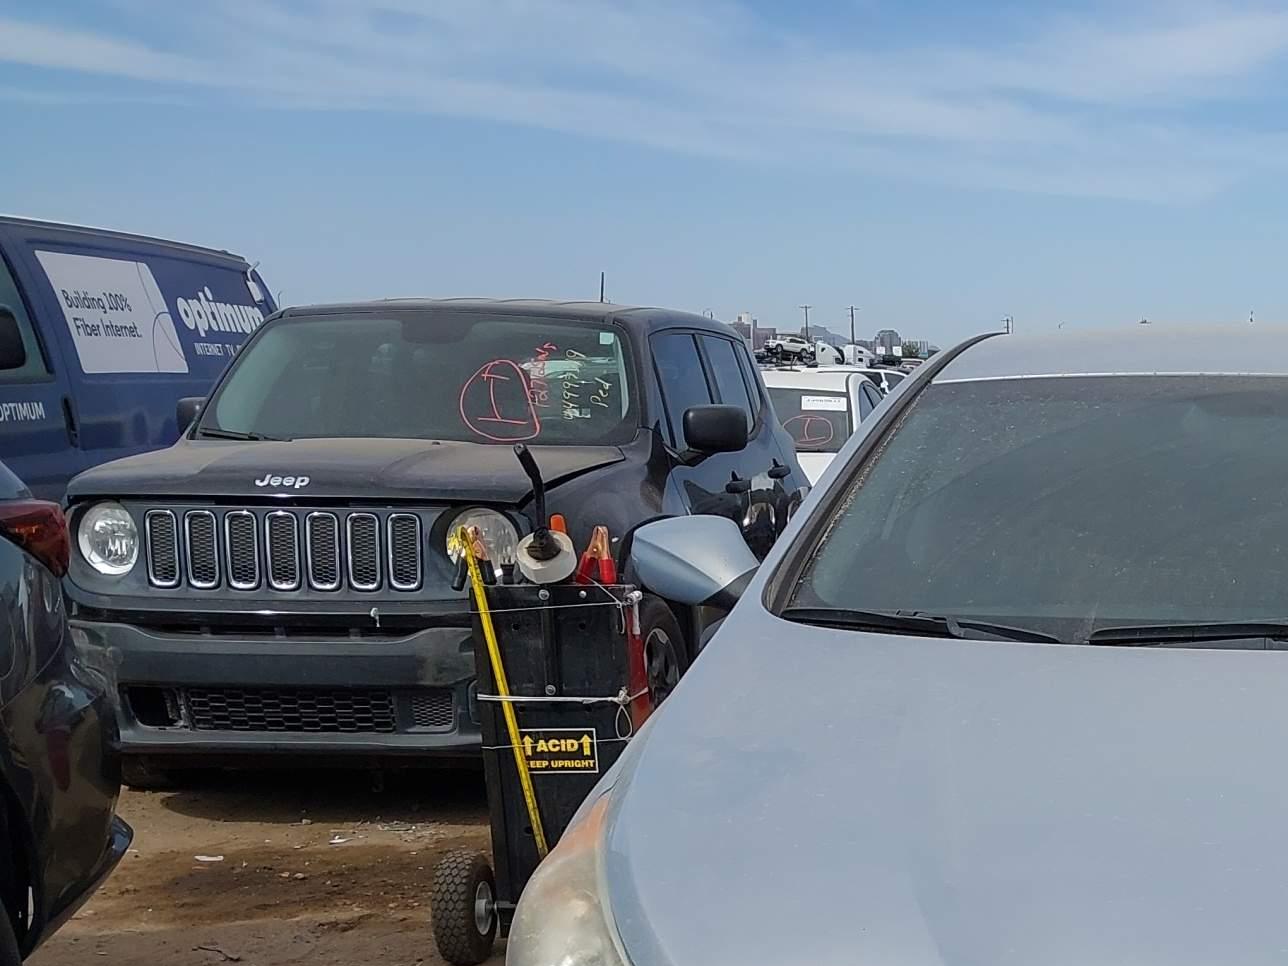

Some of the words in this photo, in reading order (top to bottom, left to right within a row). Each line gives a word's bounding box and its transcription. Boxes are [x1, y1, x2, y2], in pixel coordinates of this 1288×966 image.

[61, 289, 107, 314] Building
[102, 291, 132, 312] 100%
[177, 286, 265, 337] optimum
[72, 317, 101, 337] Fiber
[255, 473, 310, 489] Jeep
[536, 738, 580, 752] ACID
[551, 759, 595, 769] UPRIGHT
